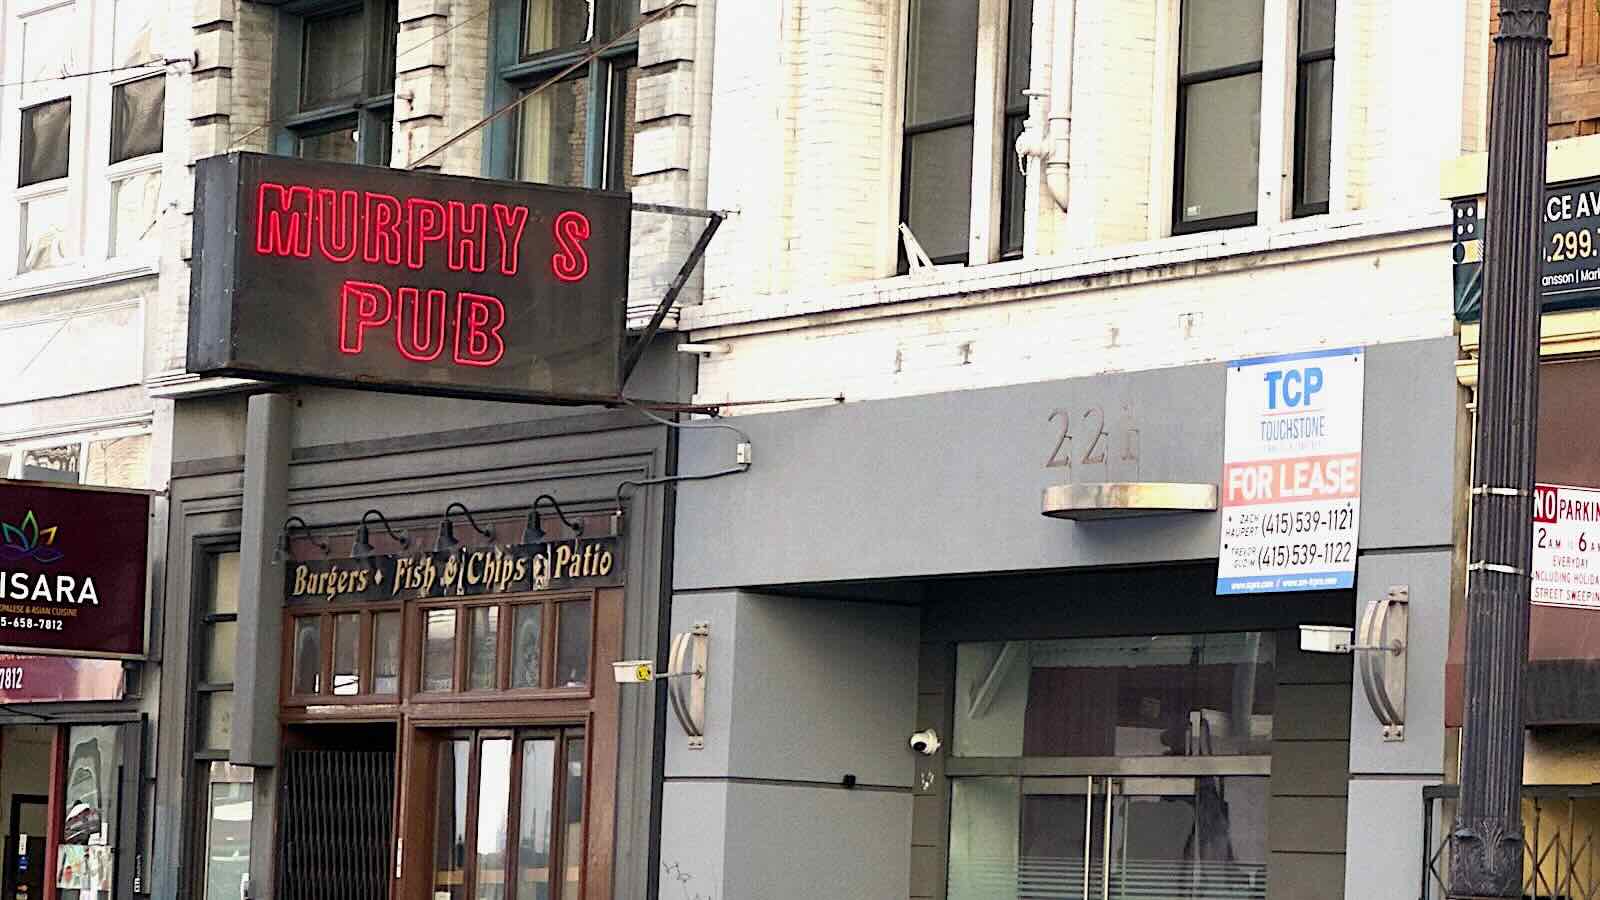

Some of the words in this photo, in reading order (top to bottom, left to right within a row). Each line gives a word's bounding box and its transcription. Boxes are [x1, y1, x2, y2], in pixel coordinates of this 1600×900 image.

[255, 182, 529, 276] MURPHY
[338, 280, 506, 367] PUB
[1264, 367, 1324, 410] TCP
[1261, 415, 1326, 441] TOUCHSTONE
[1228, 465, 1274, 501] FOR
[1279, 458, 1357, 498] LEASE
[1534, 490, 1556, 520] NO
[294, 564, 368, 600] Burgers
[393, 556, 436, 597] Fish
[466, 548, 525, 592] Chips
[554, 544, 613, 578] Patio
[1553, 555, 1589, 569] EVERYDAY
[1535, 587, 1563, 599] STREET
[52, 608, 77, 616] CUISINE
